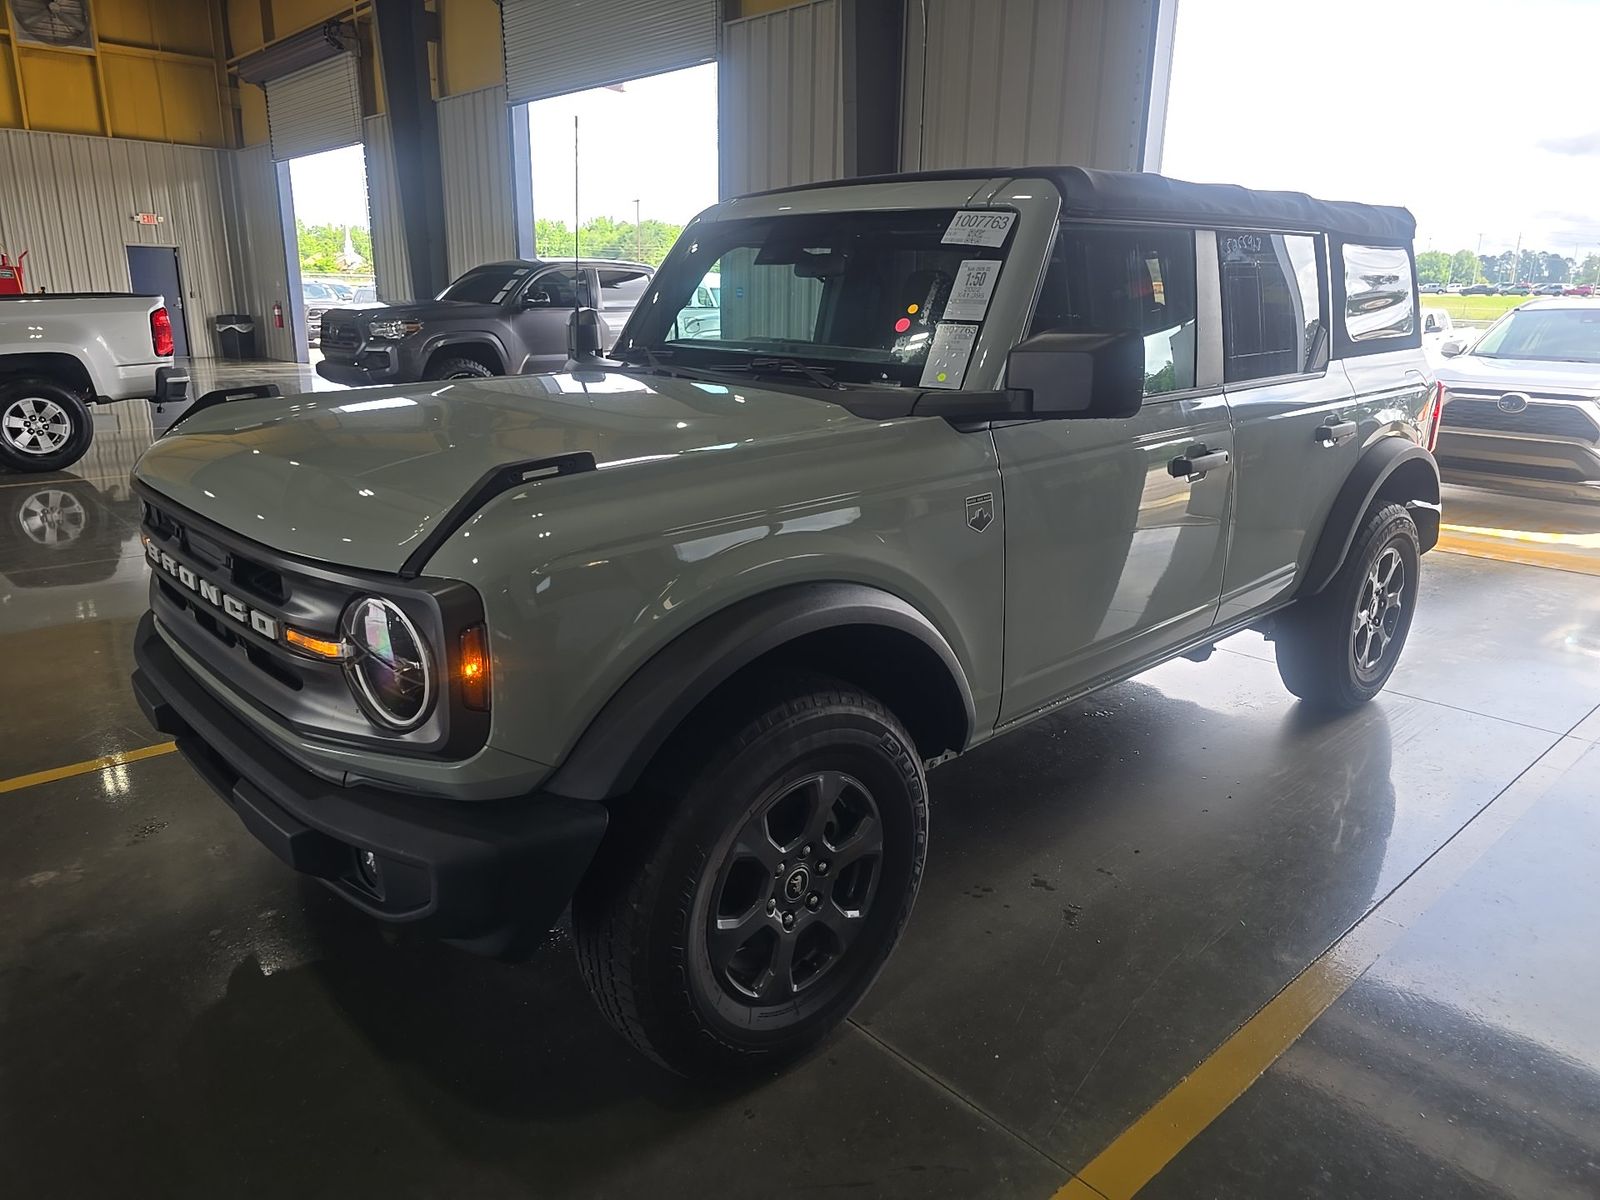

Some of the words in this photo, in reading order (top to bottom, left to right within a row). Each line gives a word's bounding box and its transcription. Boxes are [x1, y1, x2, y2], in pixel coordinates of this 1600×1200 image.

[955, 214, 1009, 230] 1007763
[965, 271, 987, 286] 1:50
[147, 540, 278, 640] BRONCO
